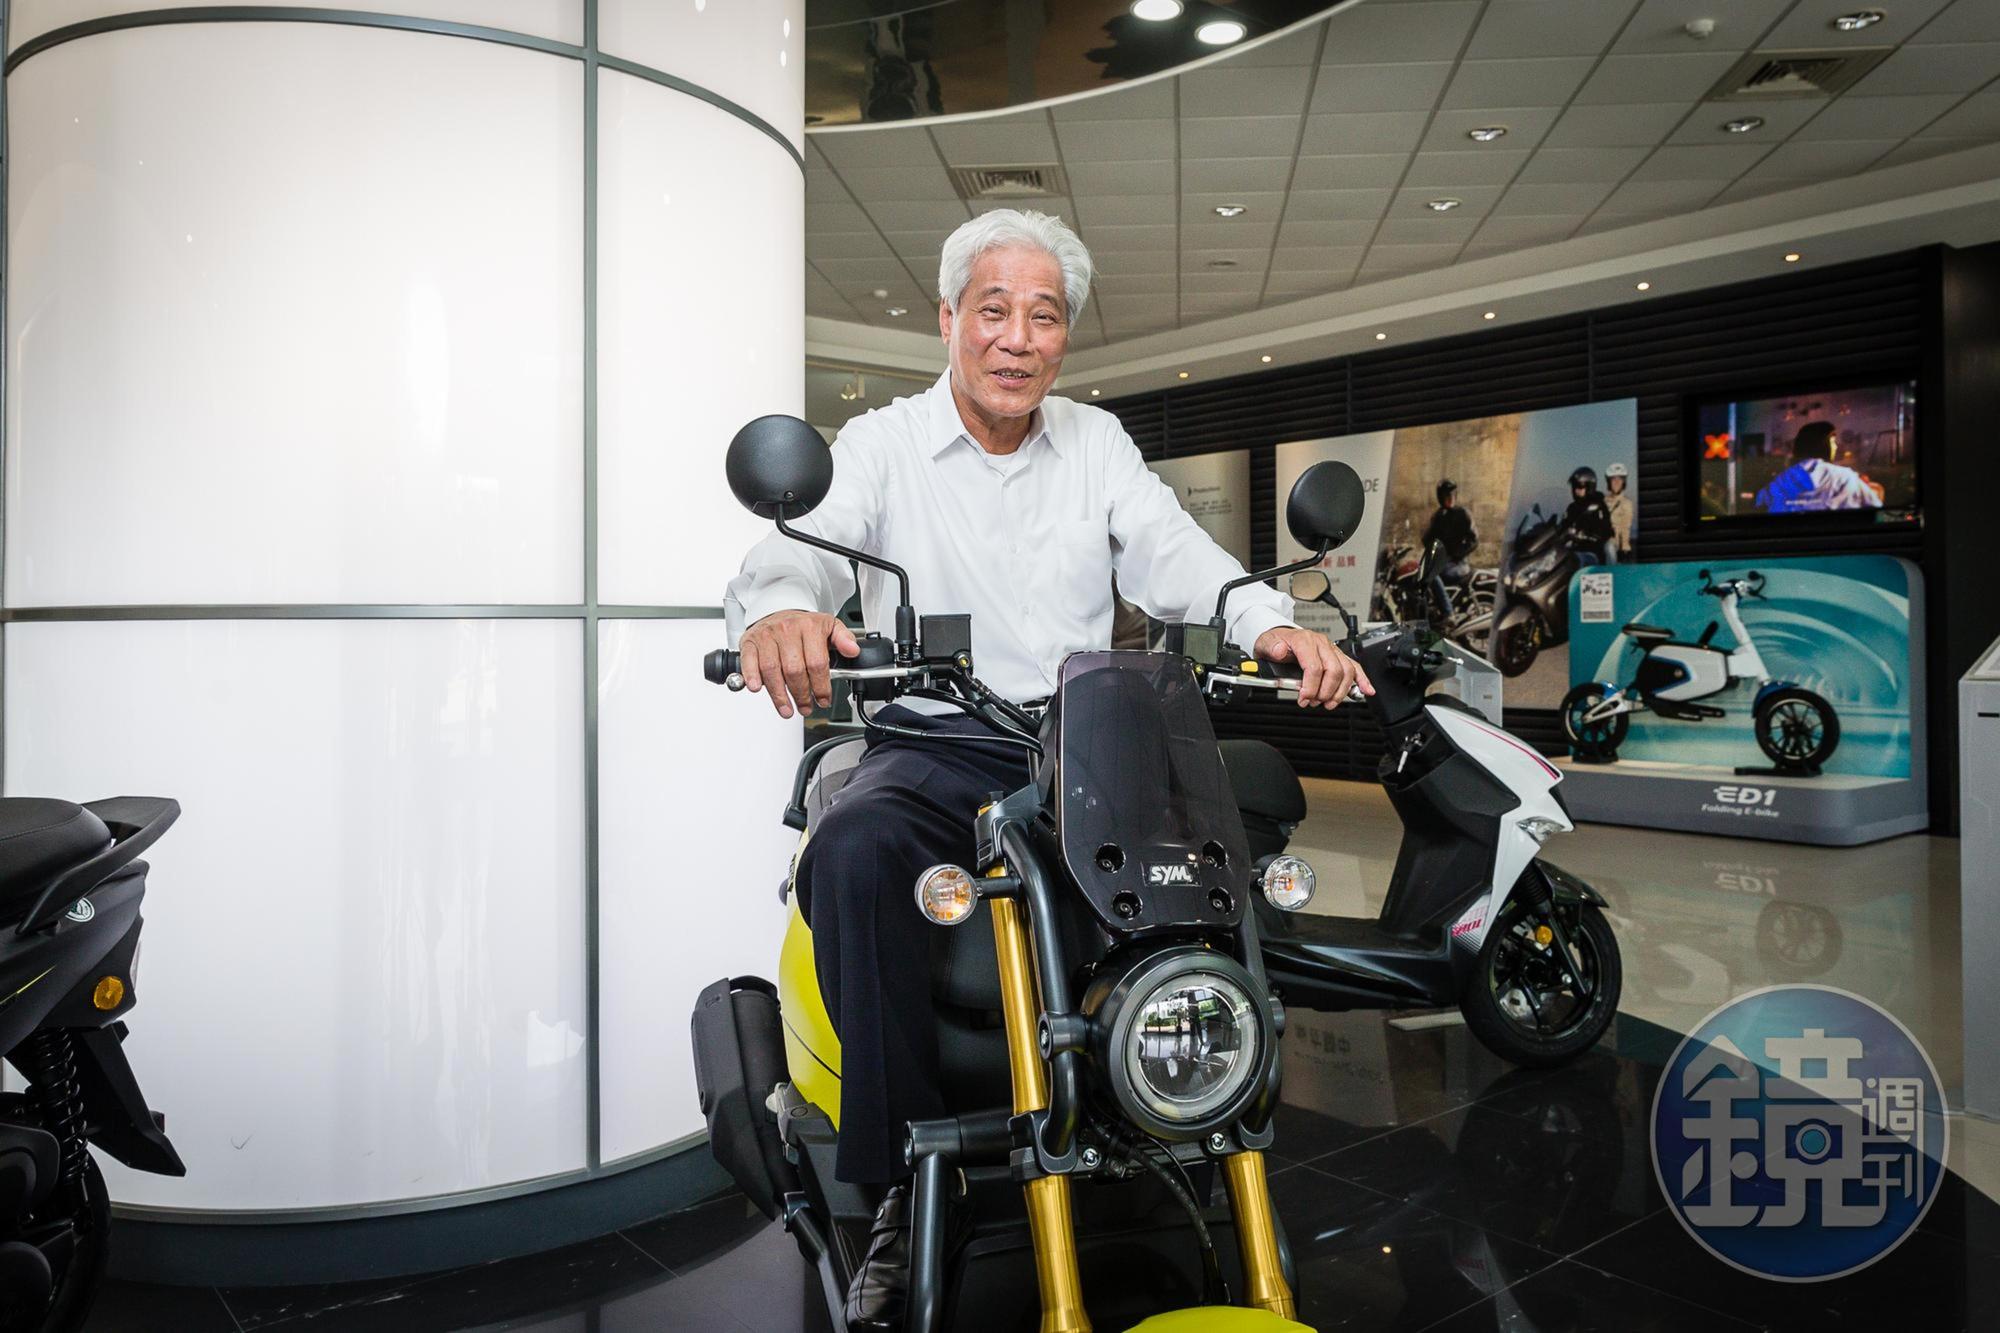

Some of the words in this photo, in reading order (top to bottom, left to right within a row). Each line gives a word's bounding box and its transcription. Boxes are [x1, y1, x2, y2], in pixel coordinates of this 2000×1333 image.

[1712, 785, 1777, 806] ED1
[1701, 803, 1743, 816] Folding
[1150, 865, 1192, 885] SYM
